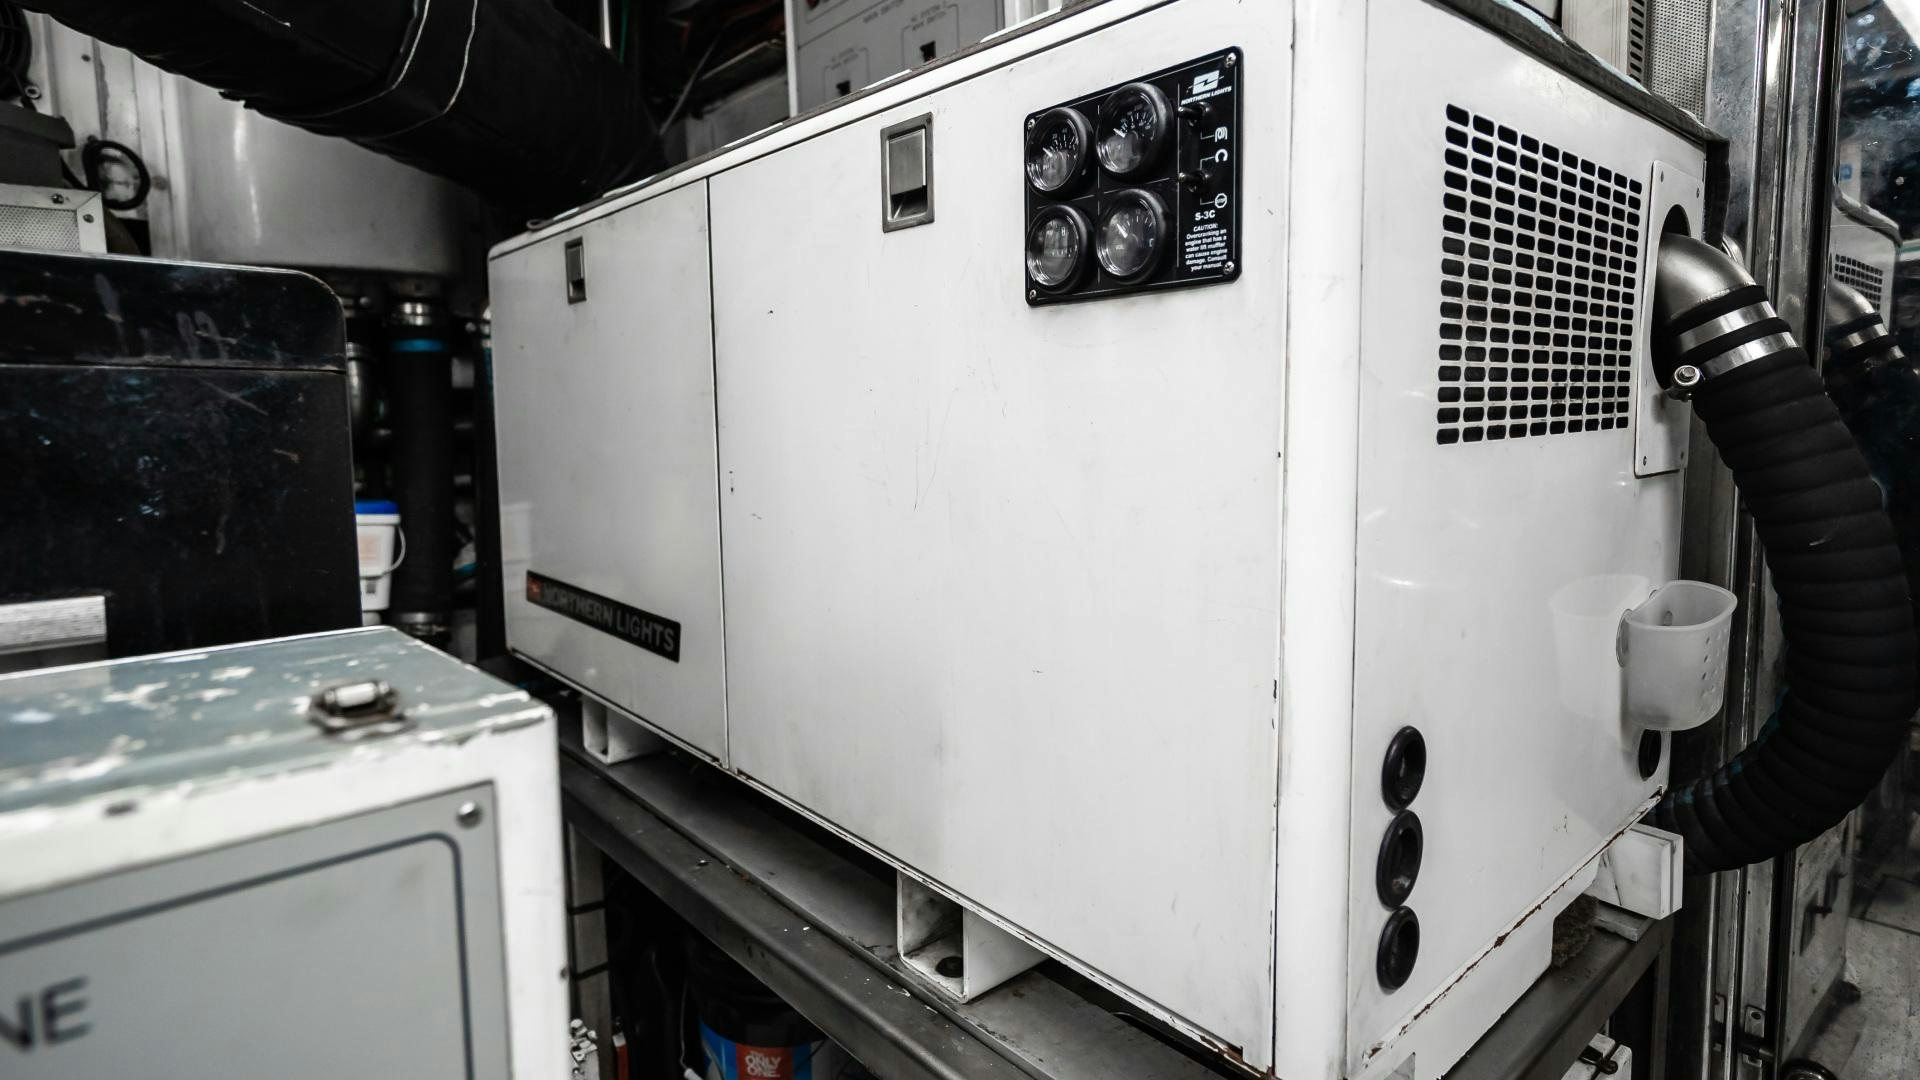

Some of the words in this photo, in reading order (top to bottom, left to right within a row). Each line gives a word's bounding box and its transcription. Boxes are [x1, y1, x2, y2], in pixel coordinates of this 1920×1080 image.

[1181, 92, 1211, 105] NORTHERN
[1211, 86, 1232, 96] LIGHTS
[1195, 210, 1215, 220] S-3C
[544, 582, 613, 627] NORTHERN
[616, 609, 675, 652] LIGHTS
[0, 976, 94, 1052] NE
[745, 1055, 781, 1069] ONLY
[747, 1065, 781, 1078] ONE
